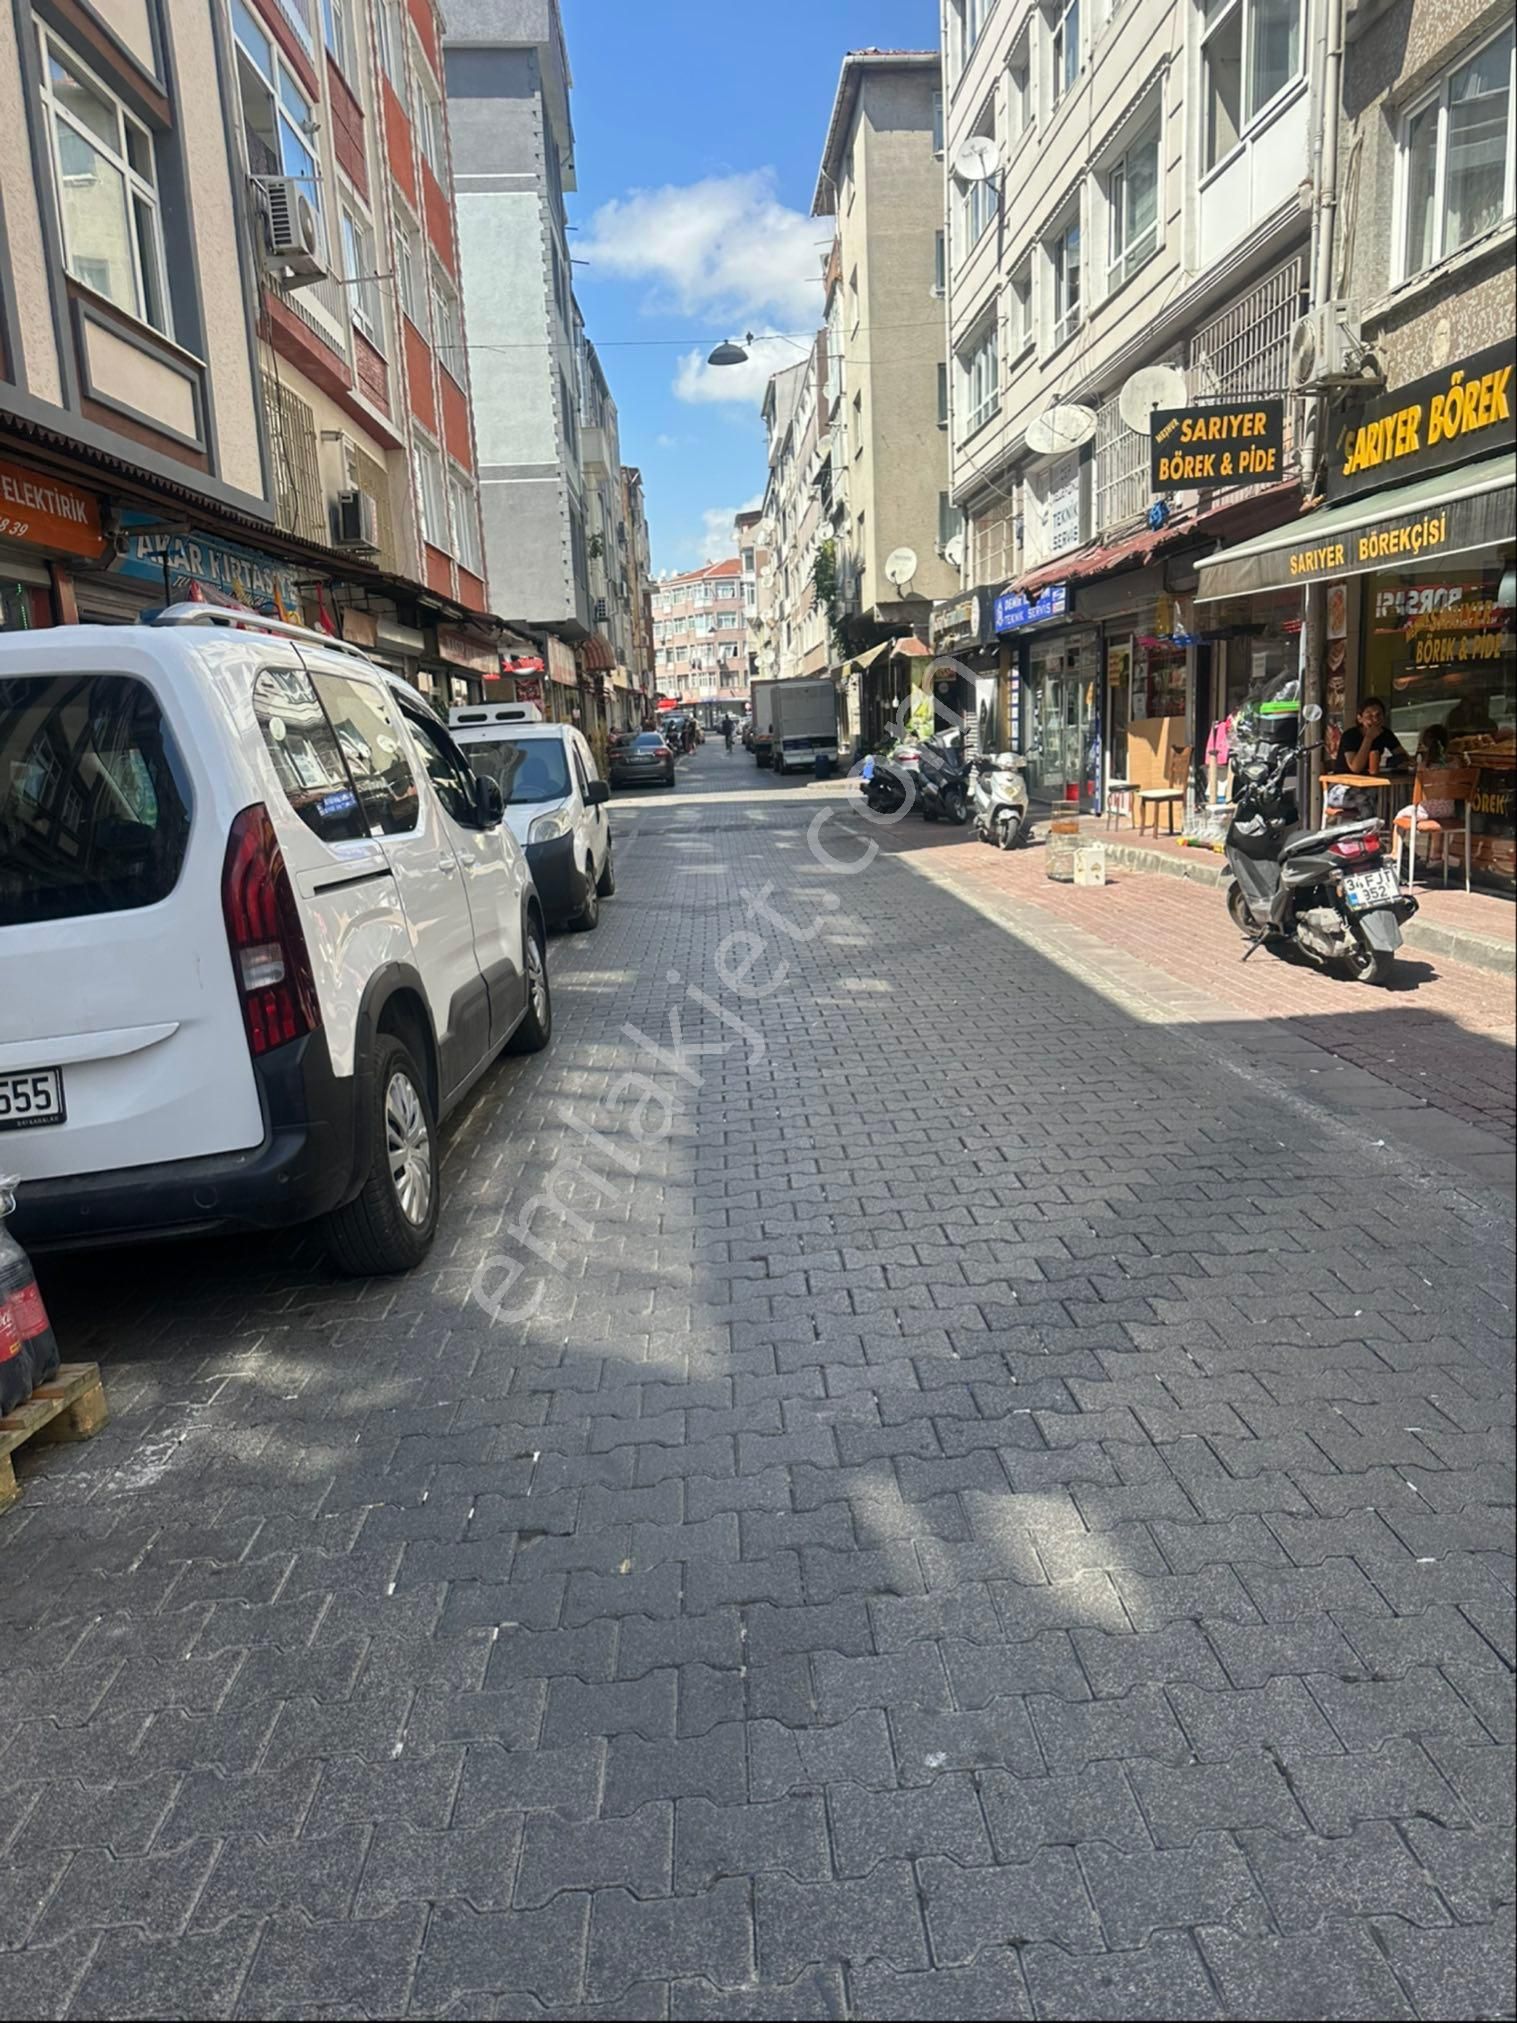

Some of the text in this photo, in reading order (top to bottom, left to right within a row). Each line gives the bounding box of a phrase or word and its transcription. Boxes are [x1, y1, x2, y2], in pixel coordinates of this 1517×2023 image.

[1180, 411, 1267, 443] SARIYER
[1343, 365, 1513, 475] SARIYER BÖREK
[1158, 444, 1276, 481] BÖREK & PİDE
[1, 475, 89, 525] ELEKTİRİK
[9, 521, 29, 537] 39
[1289, 512, 1447, 577] SARIYER BÖREKÇİSİ
[1415, 633, 1456, 664] BÖREK
[1458, 634, 1468, 661] &
